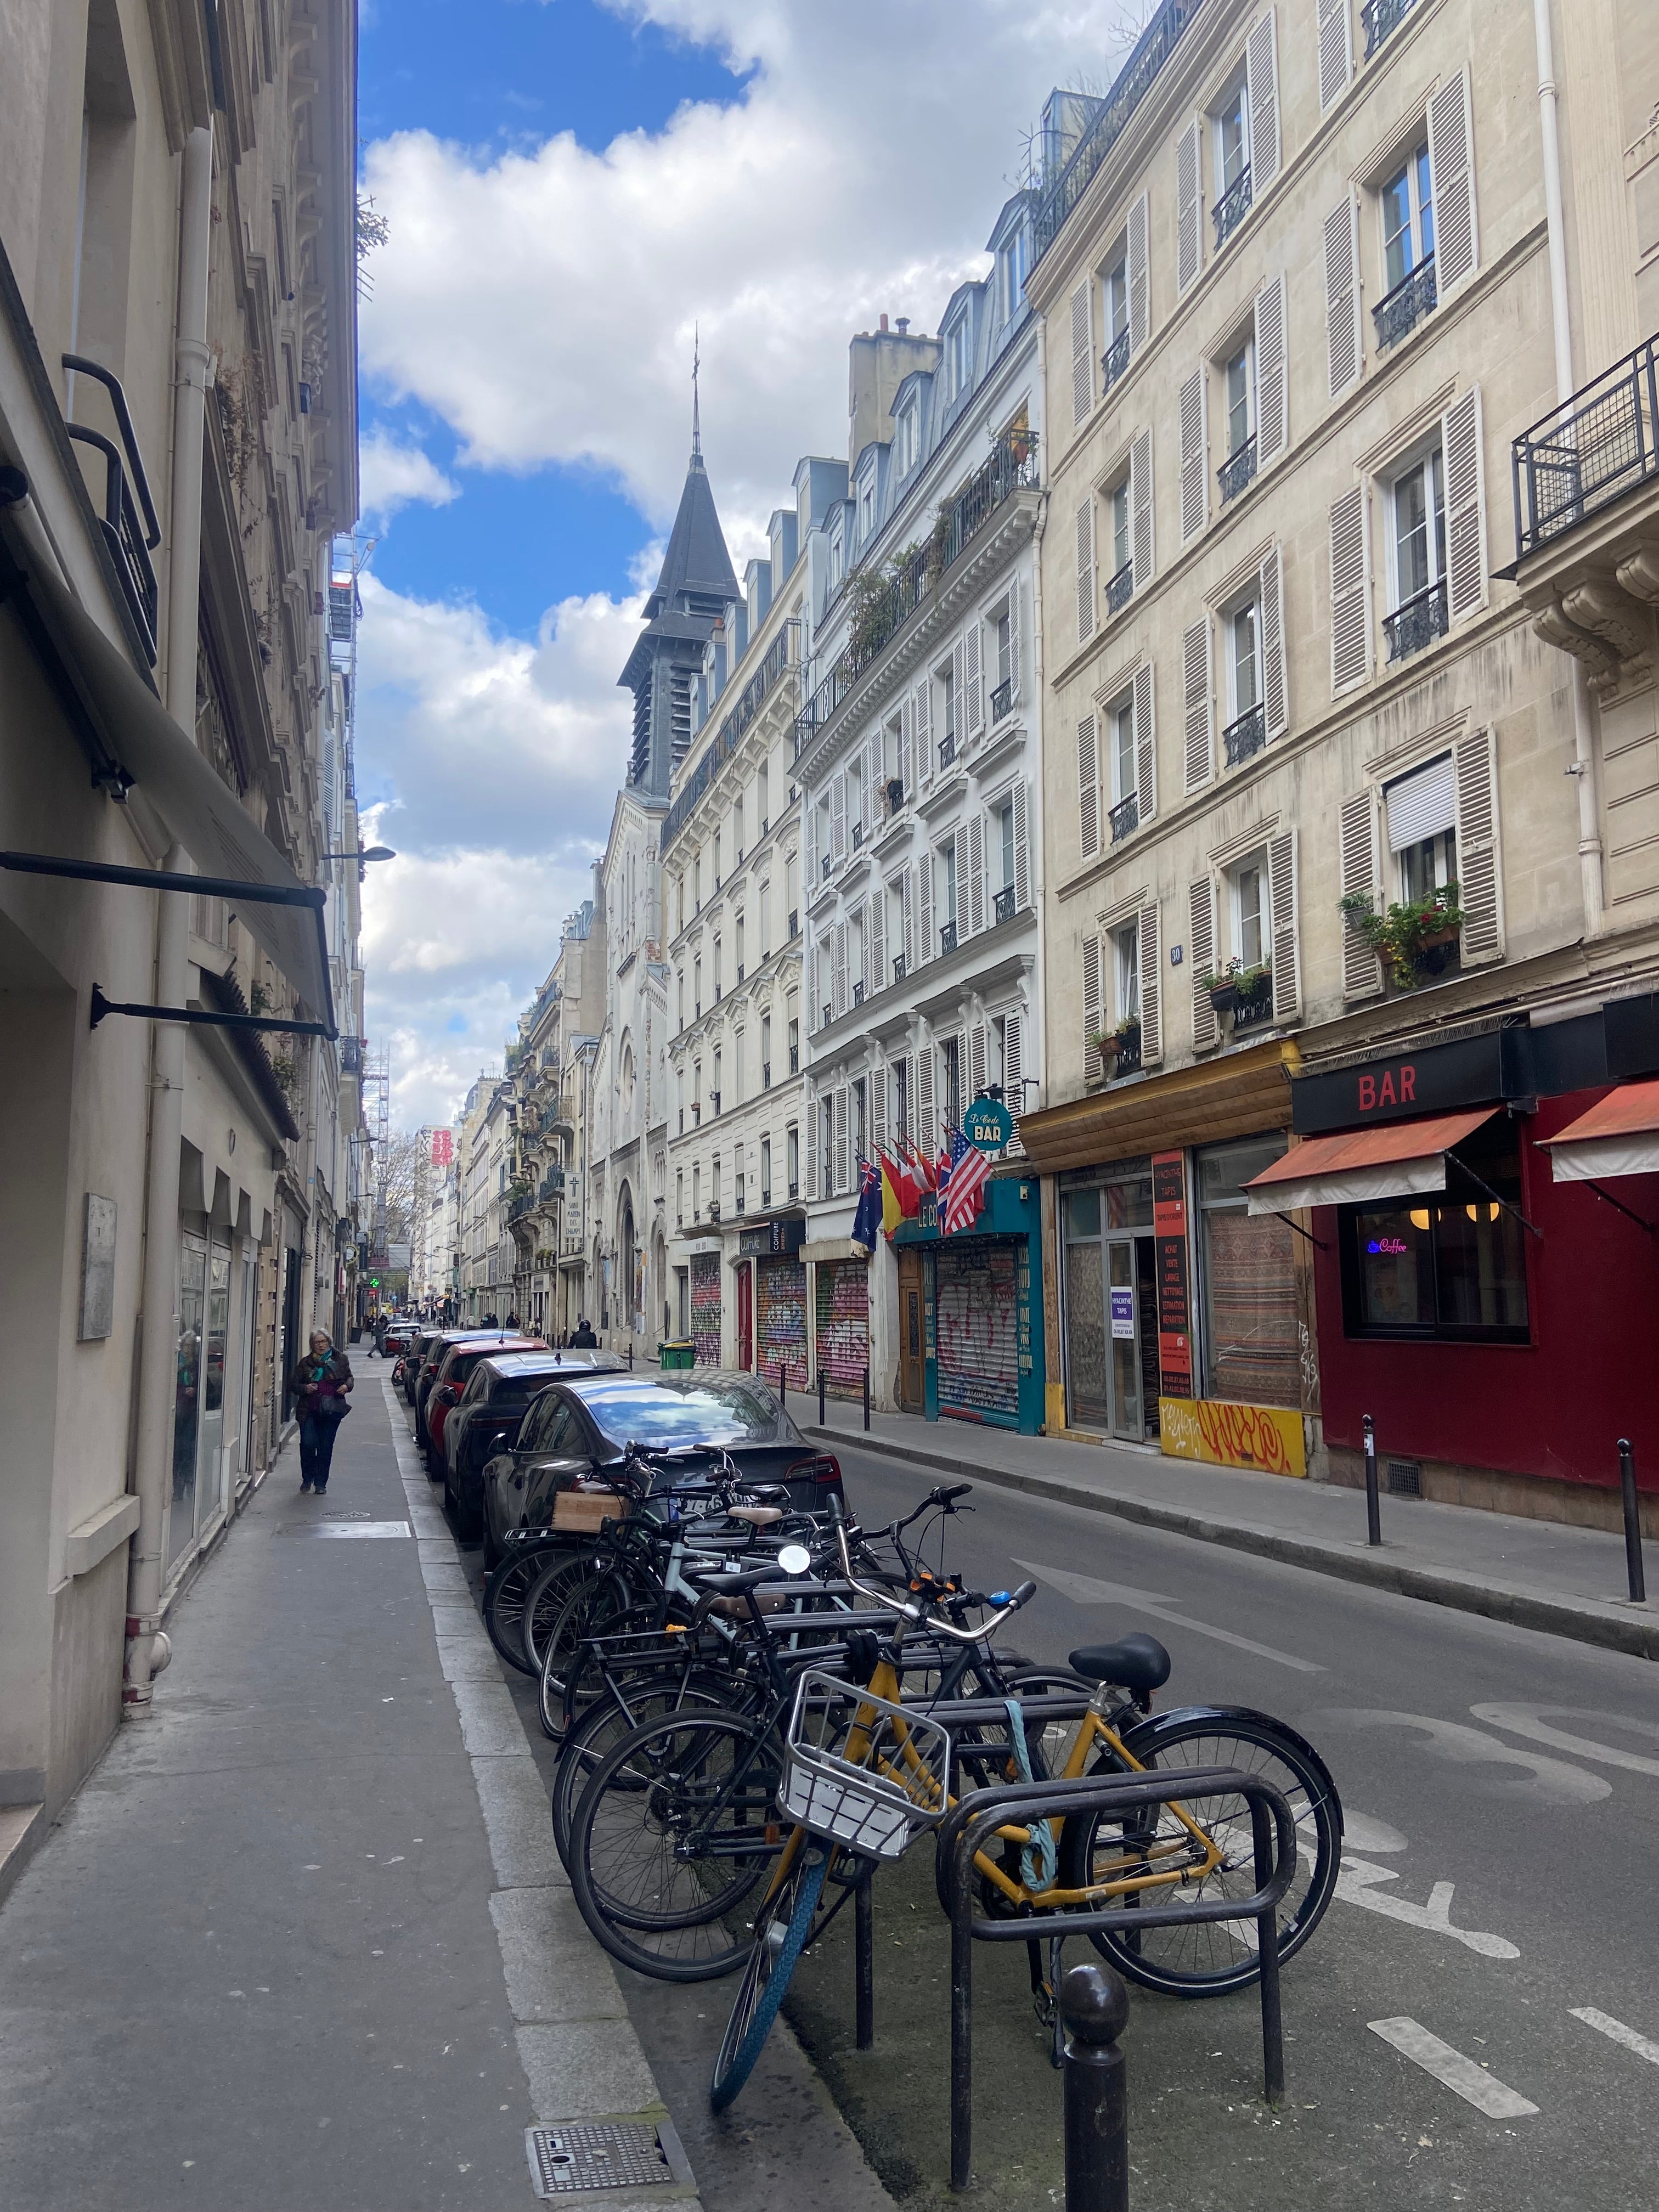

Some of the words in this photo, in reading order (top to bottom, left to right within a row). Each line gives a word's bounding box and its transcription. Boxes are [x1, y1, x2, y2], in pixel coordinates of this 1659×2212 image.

[1172, 947, 1180, 962] 30
[1358, 1065, 1416, 1111] BAR
[980, 1114, 999, 1124] Code
[974, 1126, 1001, 1142] BAR
[1154, 1167, 1181, 1179] HYACINTHE
[1161, 1186, 1176, 1197] TAPIS
[918, 1206, 927, 1228] LE
[928, 1204, 939, 1227] CO
[741, 1234, 760, 1251] COIFFURE
[1379, 1238, 1408, 1255] Coffee
[1165, 1245, 1178, 1254] ACHAT
[1166, 1259, 1178, 1268] VENTE
[1165, 1273, 1180, 1282] LAVAGE
[1163, 1287, 1184, 1296] NETTOYAGE
[1163, 1301, 1184, 1311] ESTIMATION
